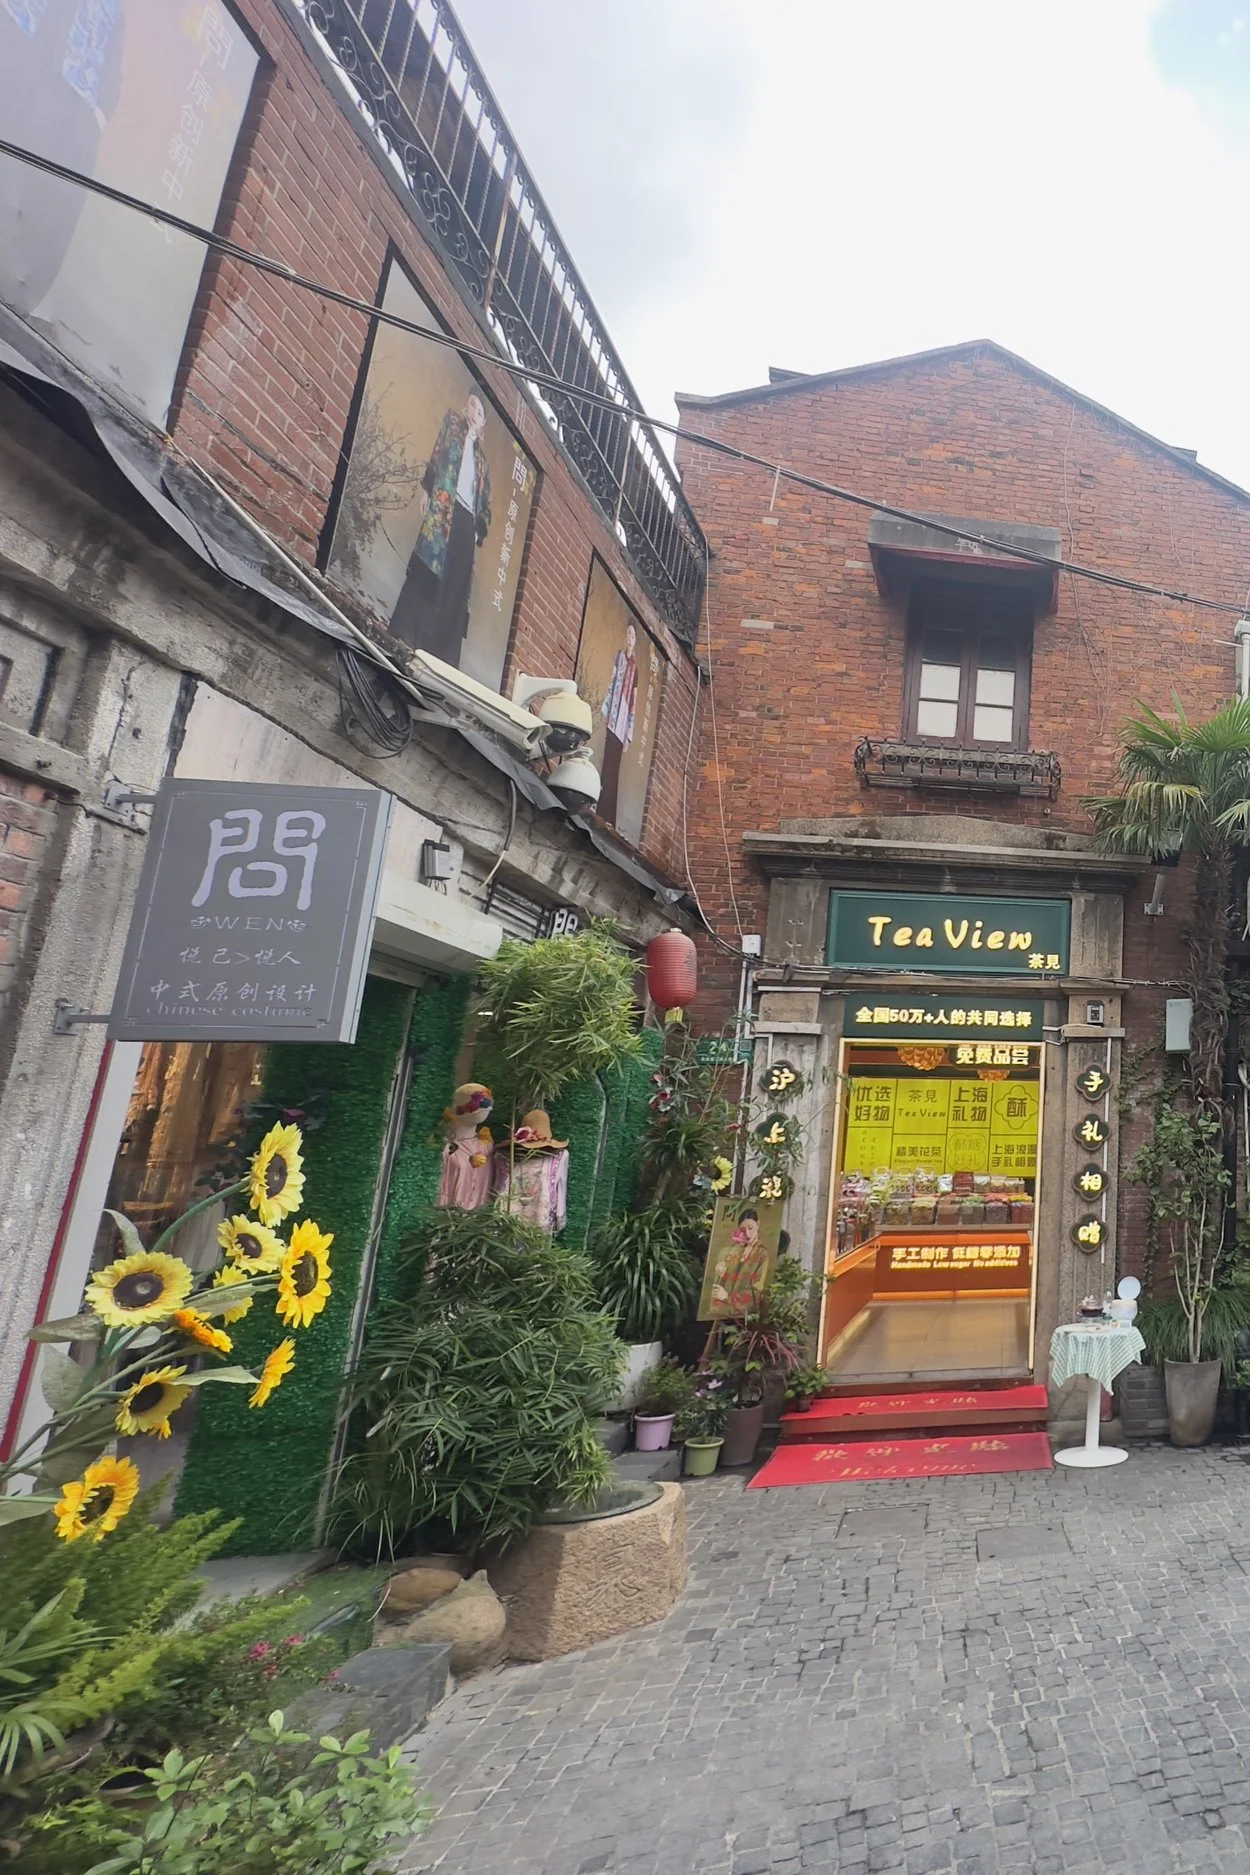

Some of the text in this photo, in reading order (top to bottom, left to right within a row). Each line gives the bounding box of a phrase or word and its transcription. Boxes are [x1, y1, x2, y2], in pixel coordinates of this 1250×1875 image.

[191, 808, 327, 911] 問
[215, 916, 284, 931] WEN
[868, 916, 1033, 951] Tea View
[150, 979, 318, 1003] 中式原创设计
[855, 1006, 1033, 1029] 全国50万+人的共同选择
[956, 1045, 1029, 1066] 免费品尝
[920, 1108, 947, 1118] View
